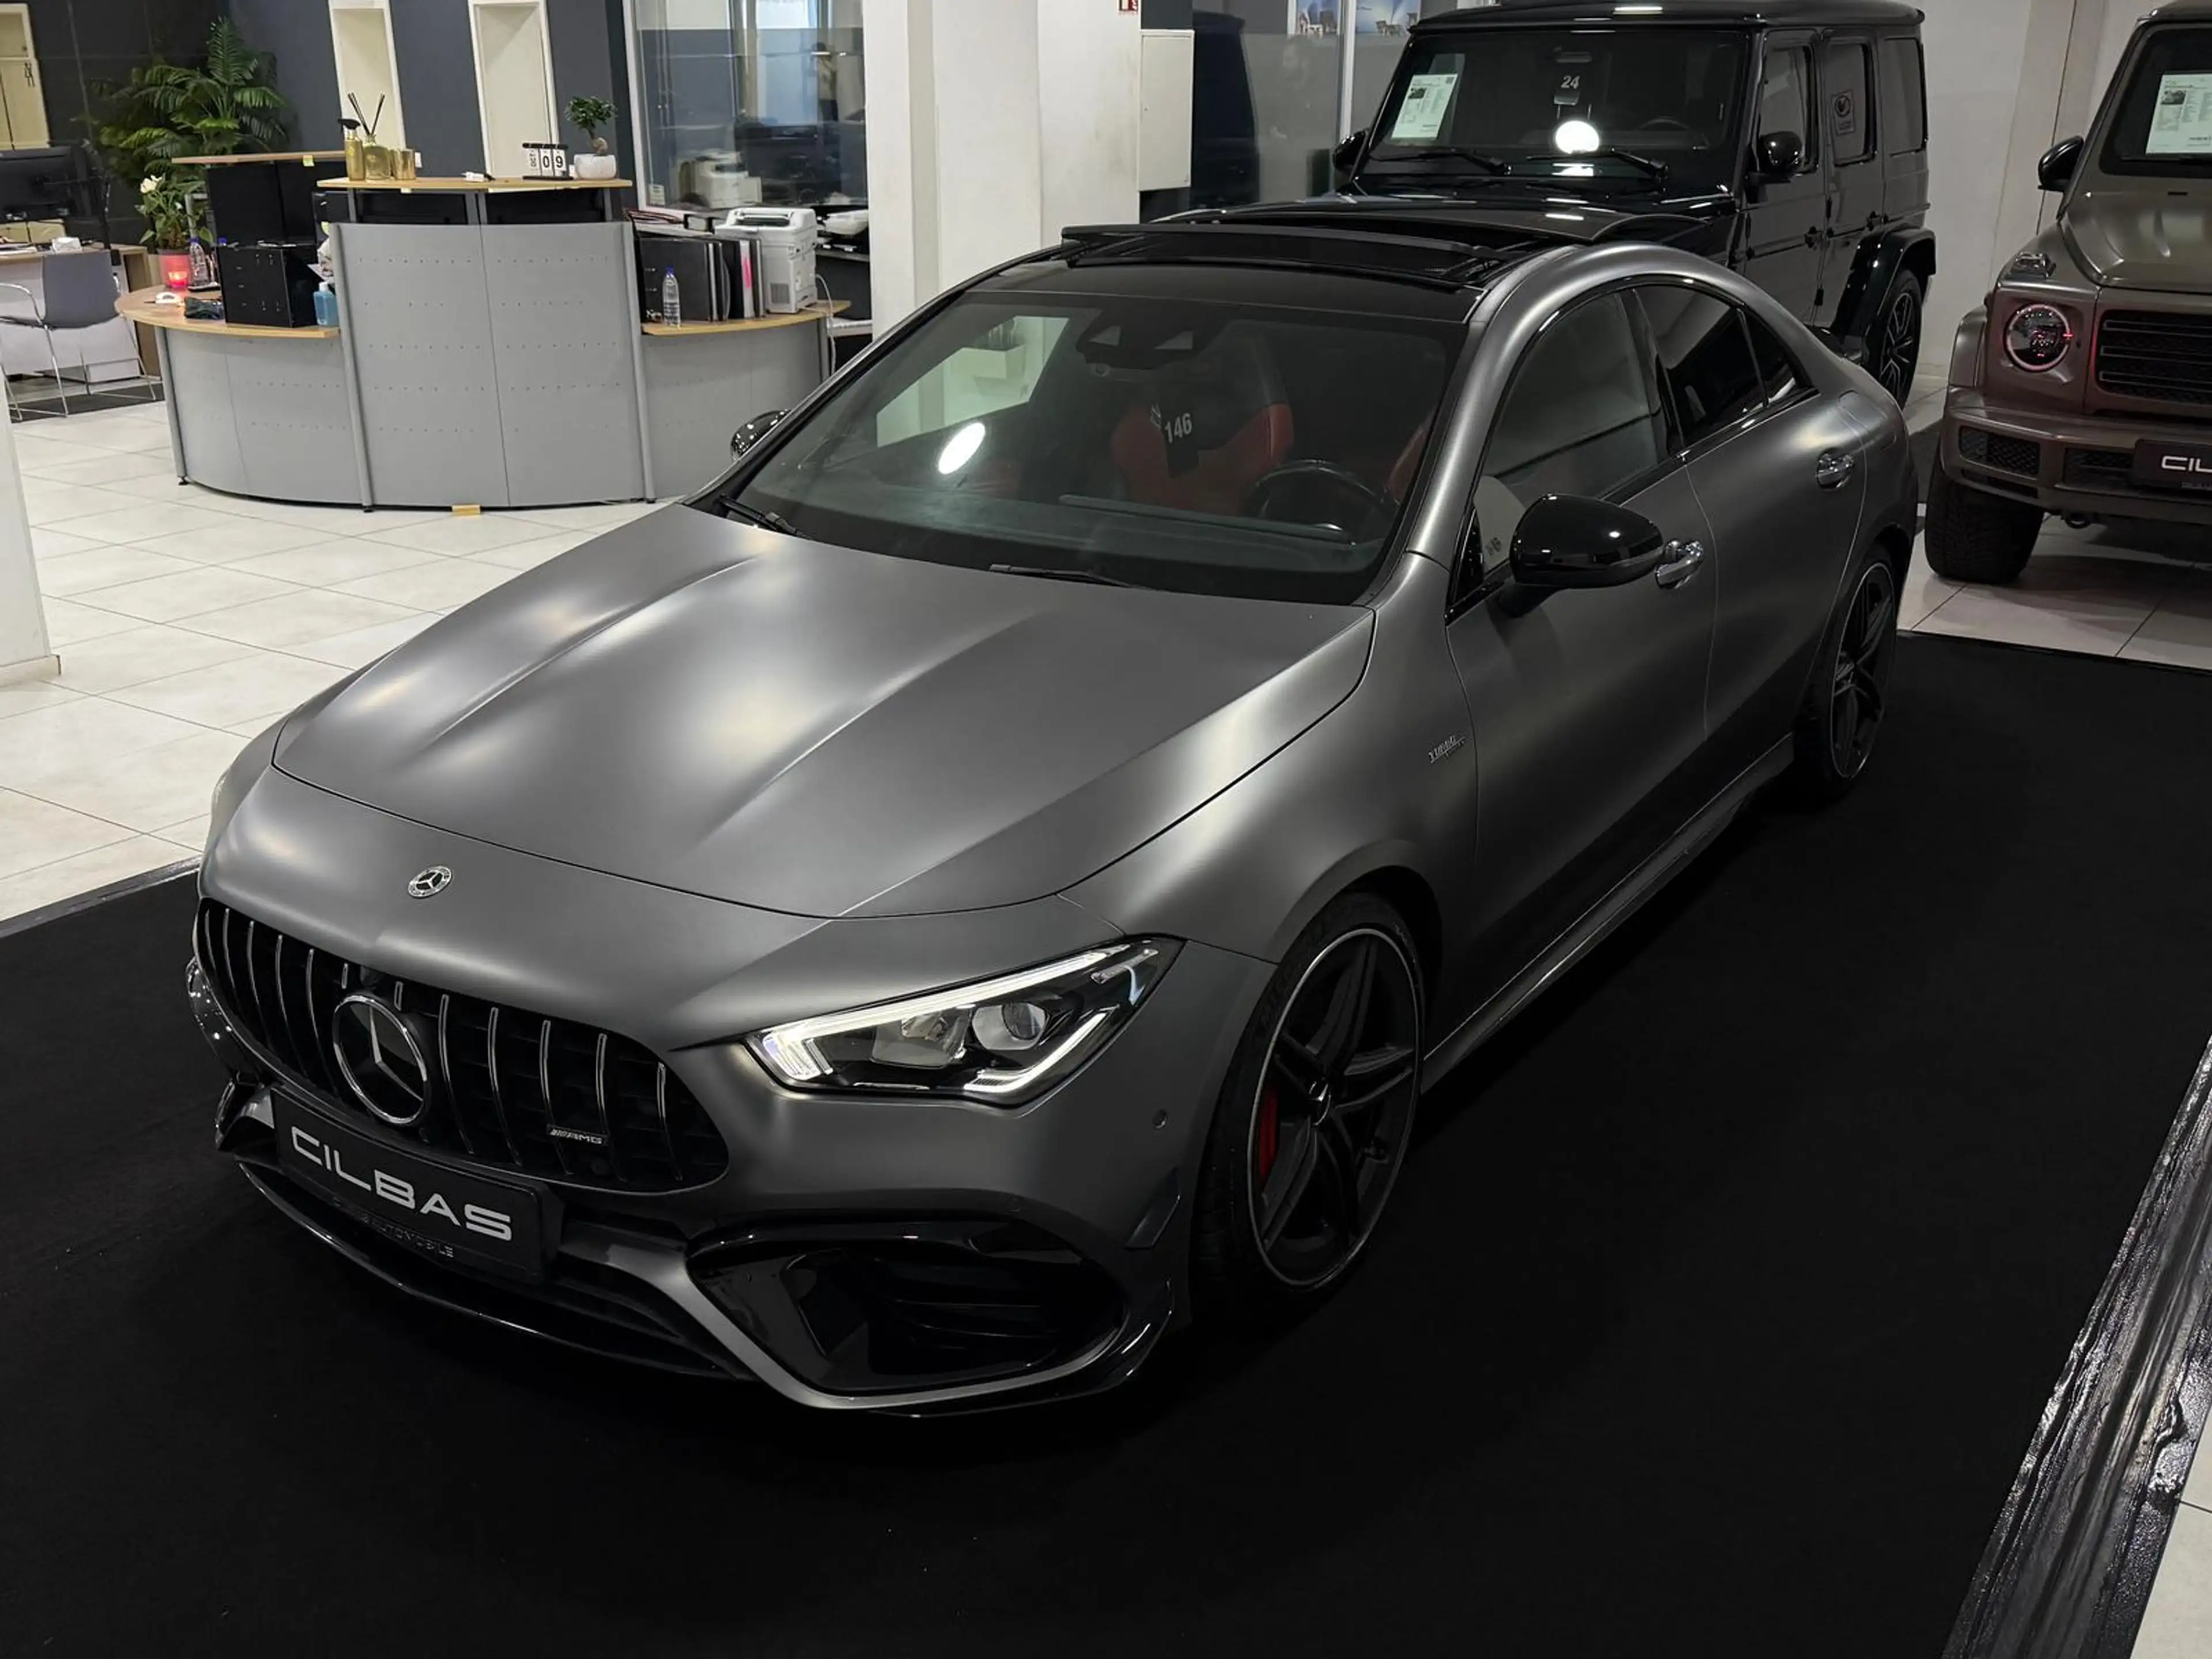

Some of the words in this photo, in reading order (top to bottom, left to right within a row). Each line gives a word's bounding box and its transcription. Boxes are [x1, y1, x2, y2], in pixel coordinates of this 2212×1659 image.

[1560, 74, 1581, 90] 24
[1164, 412, 1193, 444] 146
[291, 1126, 513, 1241] CILBAS
